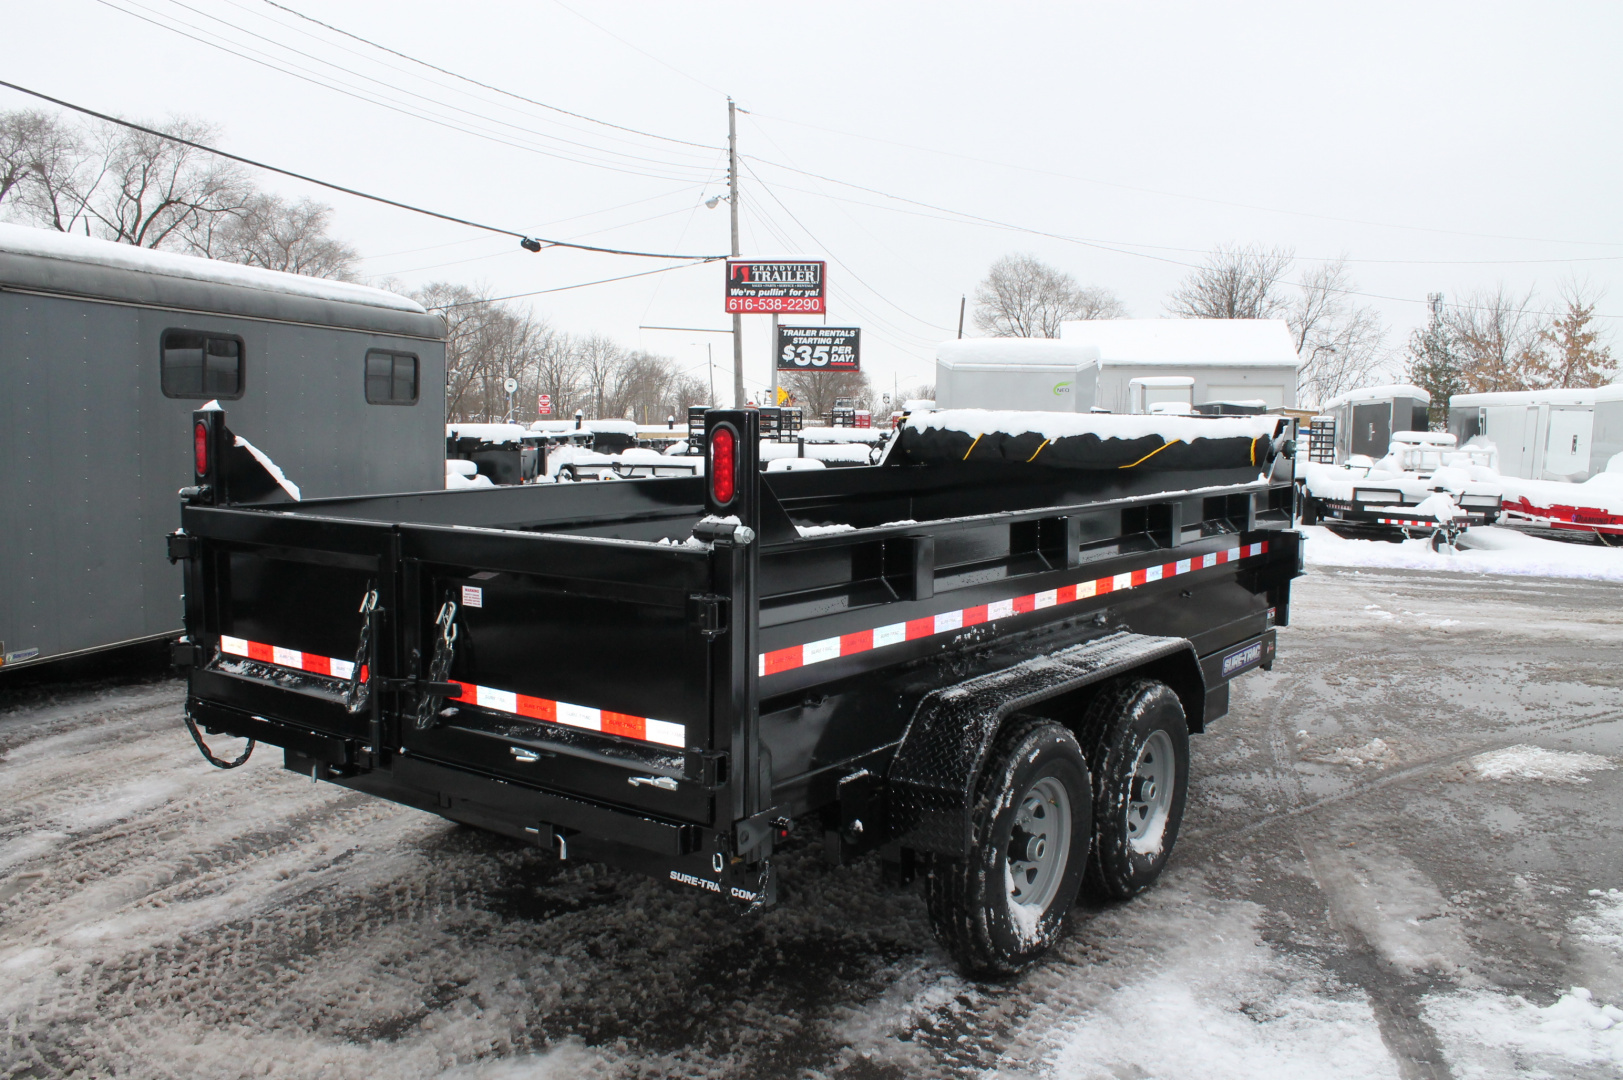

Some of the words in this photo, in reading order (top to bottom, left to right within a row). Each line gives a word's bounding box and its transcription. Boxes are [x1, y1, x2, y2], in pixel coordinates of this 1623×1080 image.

[752, 271, 815, 282] TRAILER
[730, 288, 756, 296] We're
[757, 288, 787, 297] pullin'
[789, 288, 803, 296] for
[804, 288, 820, 297] ya!
[729, 298, 820, 311] 616-538-2290
[783, 329, 818, 337] TRAILER
[818, 329, 856, 337] RENTALS
[792, 337, 832, 345] STARTING
[833, 337, 846, 345] AT
[782, 343, 830, 367] $35
[831, 346, 852, 354] PER
[830, 354, 855, 363] DAY!
